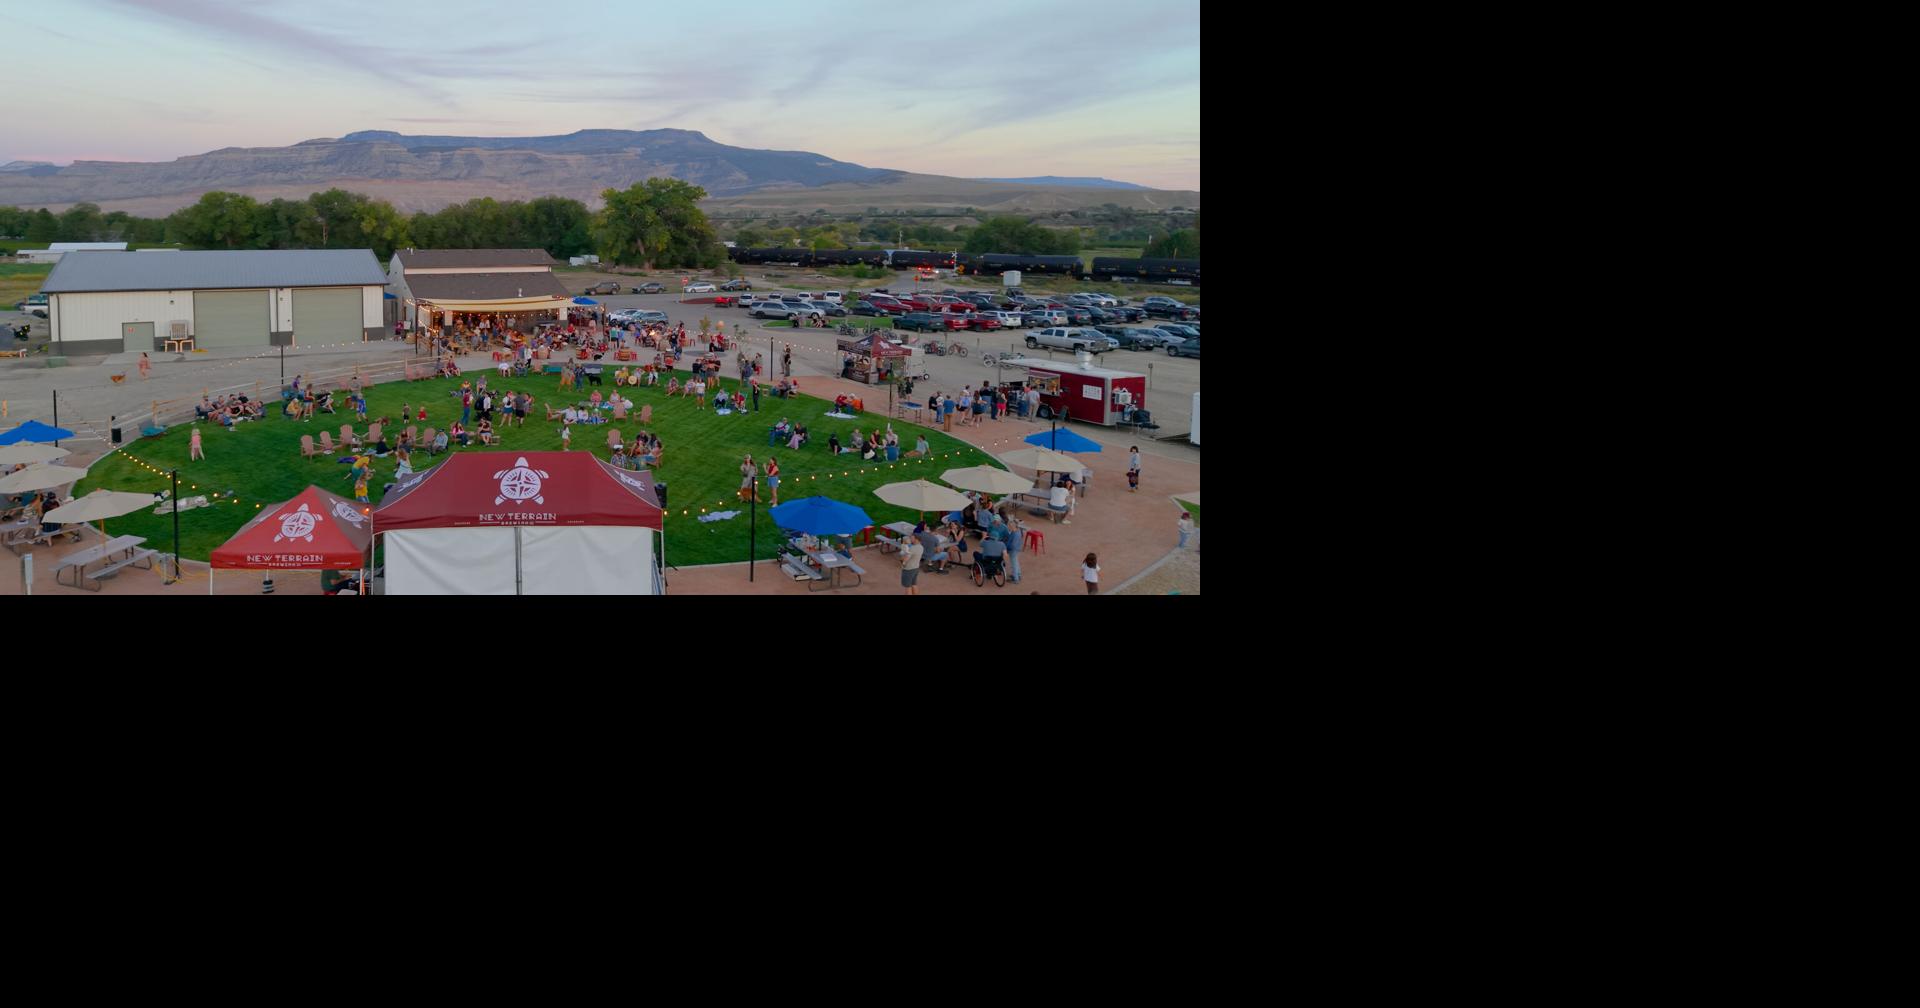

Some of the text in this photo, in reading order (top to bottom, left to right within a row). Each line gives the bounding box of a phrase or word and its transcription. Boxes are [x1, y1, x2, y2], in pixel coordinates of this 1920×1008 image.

[479, 513, 505, 521] NEW
[247, 554, 323, 562] NEW TERRAIN
